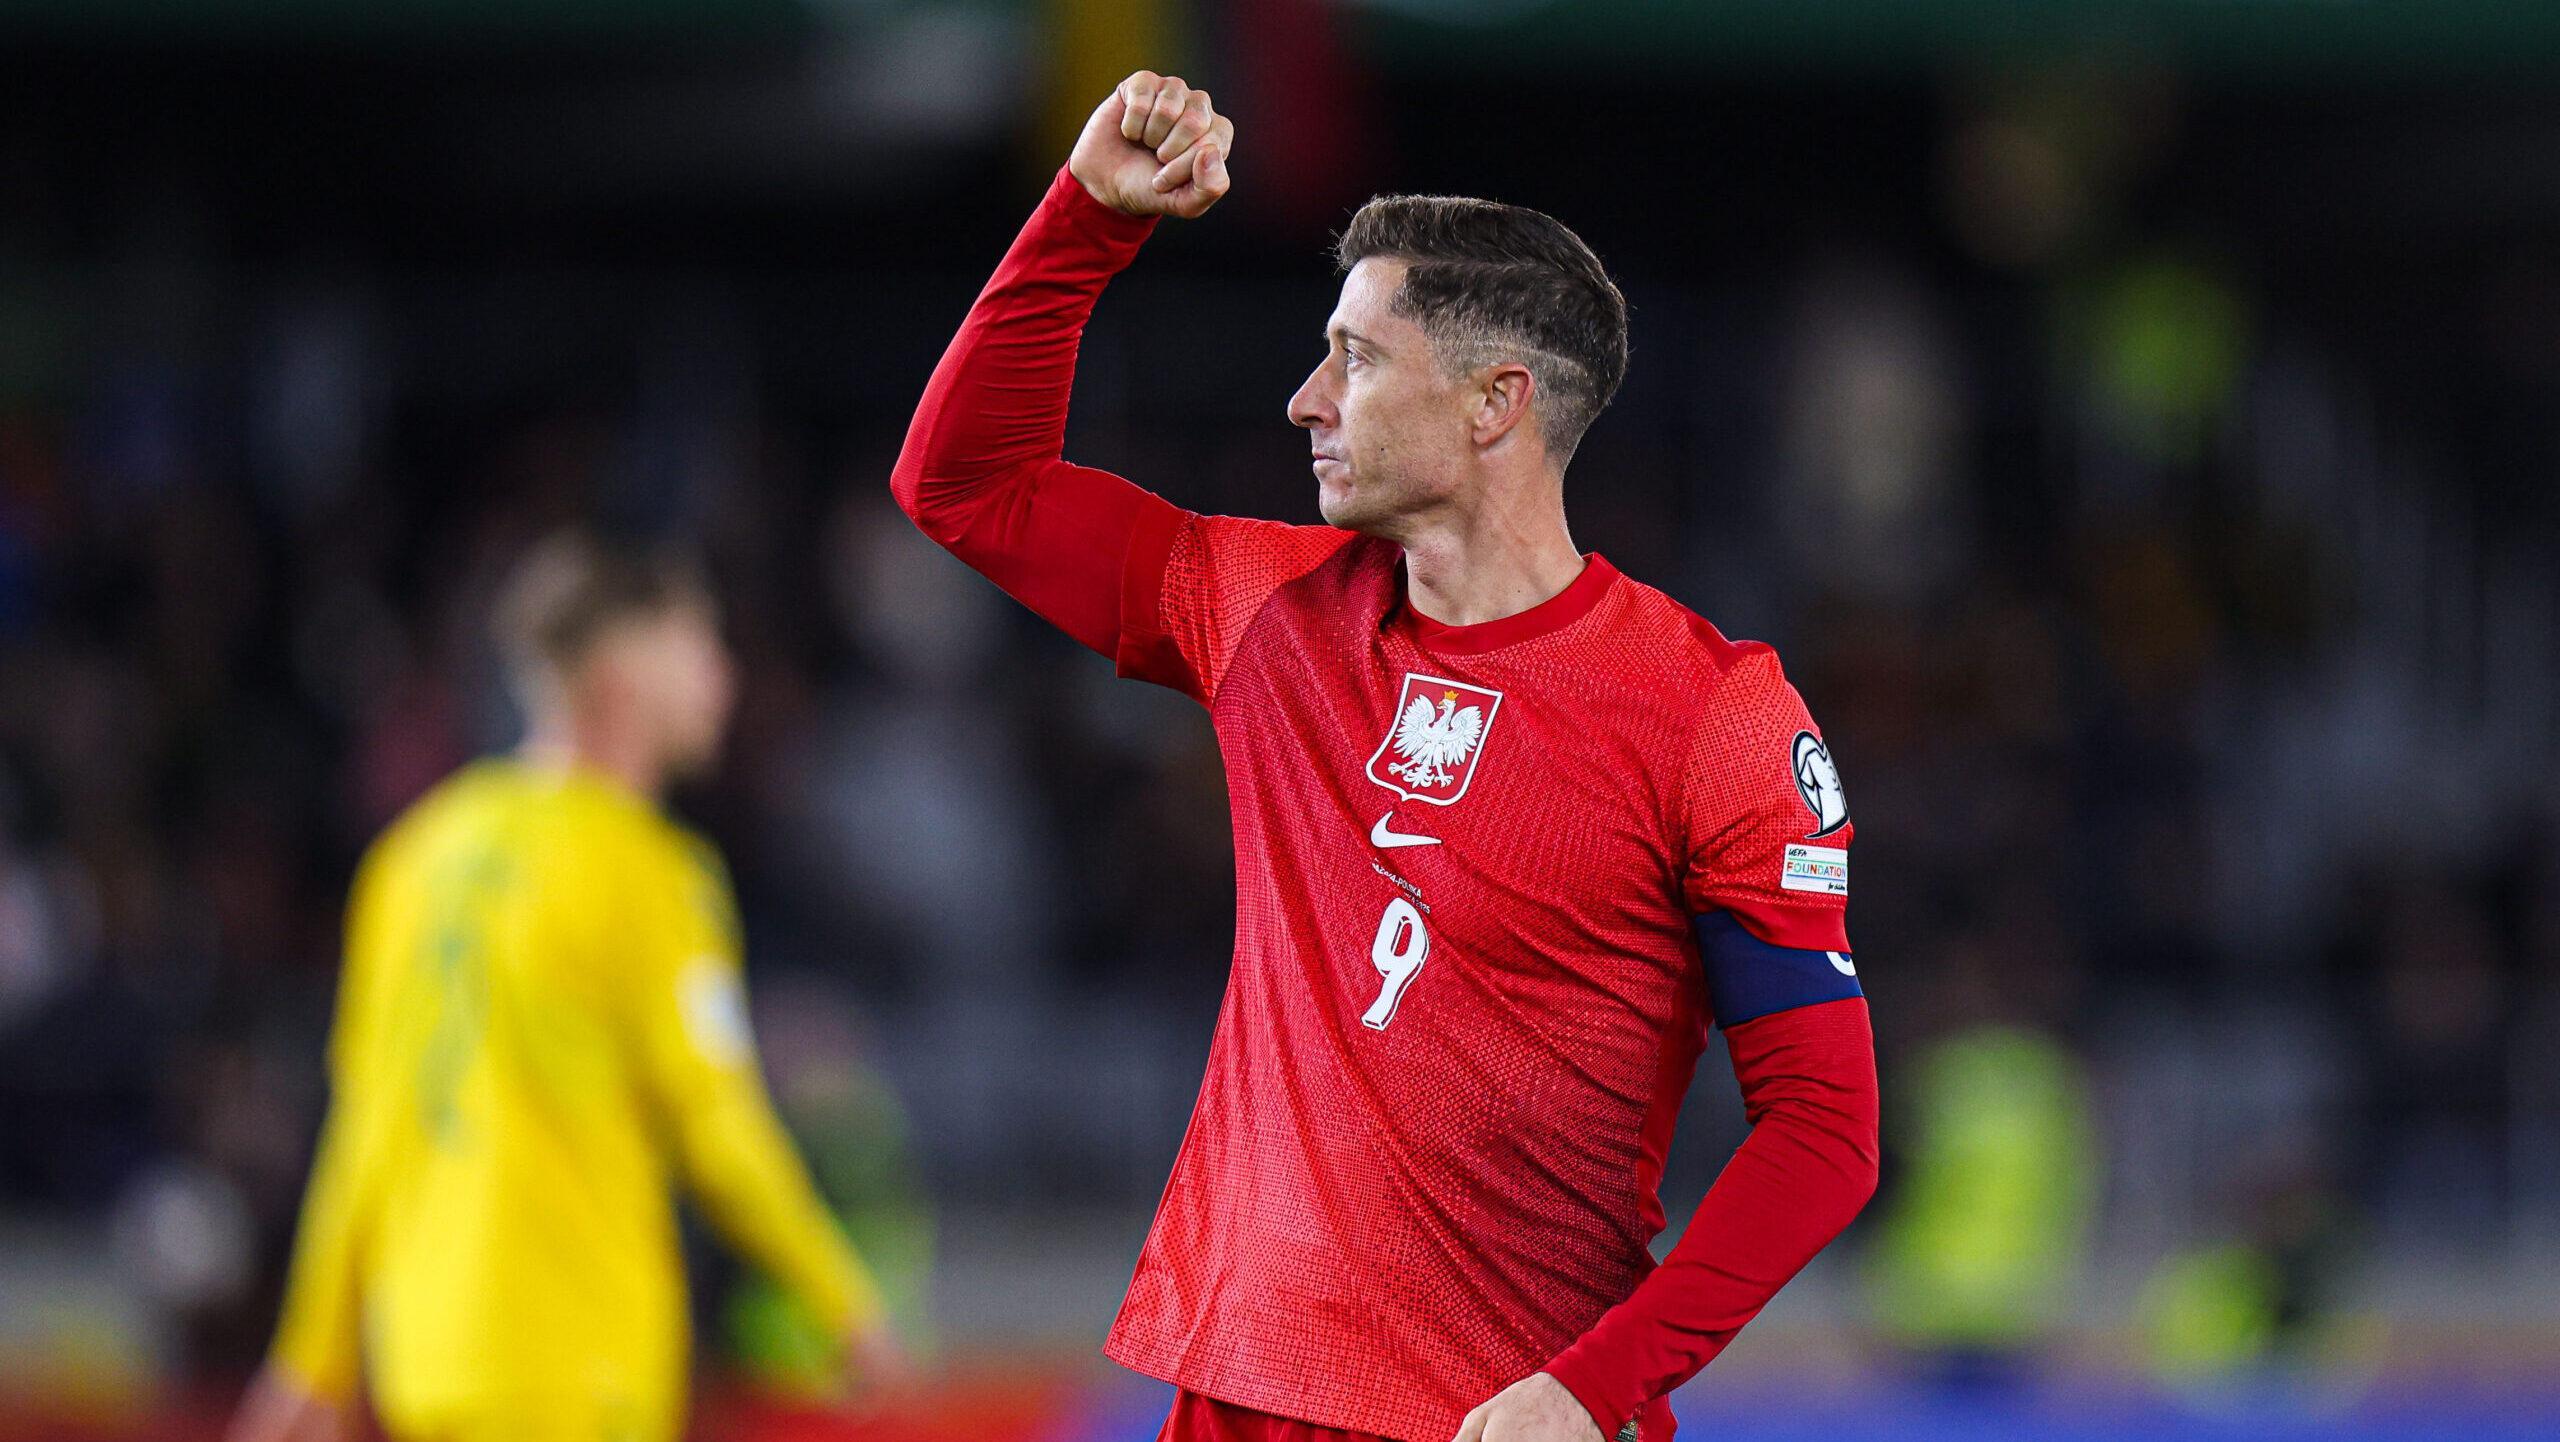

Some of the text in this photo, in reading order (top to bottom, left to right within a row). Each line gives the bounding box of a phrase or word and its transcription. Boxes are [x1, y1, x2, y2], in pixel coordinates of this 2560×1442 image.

[1788, 848, 1807, 857] UEFA
[1786, 861, 1846, 878] FOUNDATION
[1361, 896, 1430, 1031] 9
